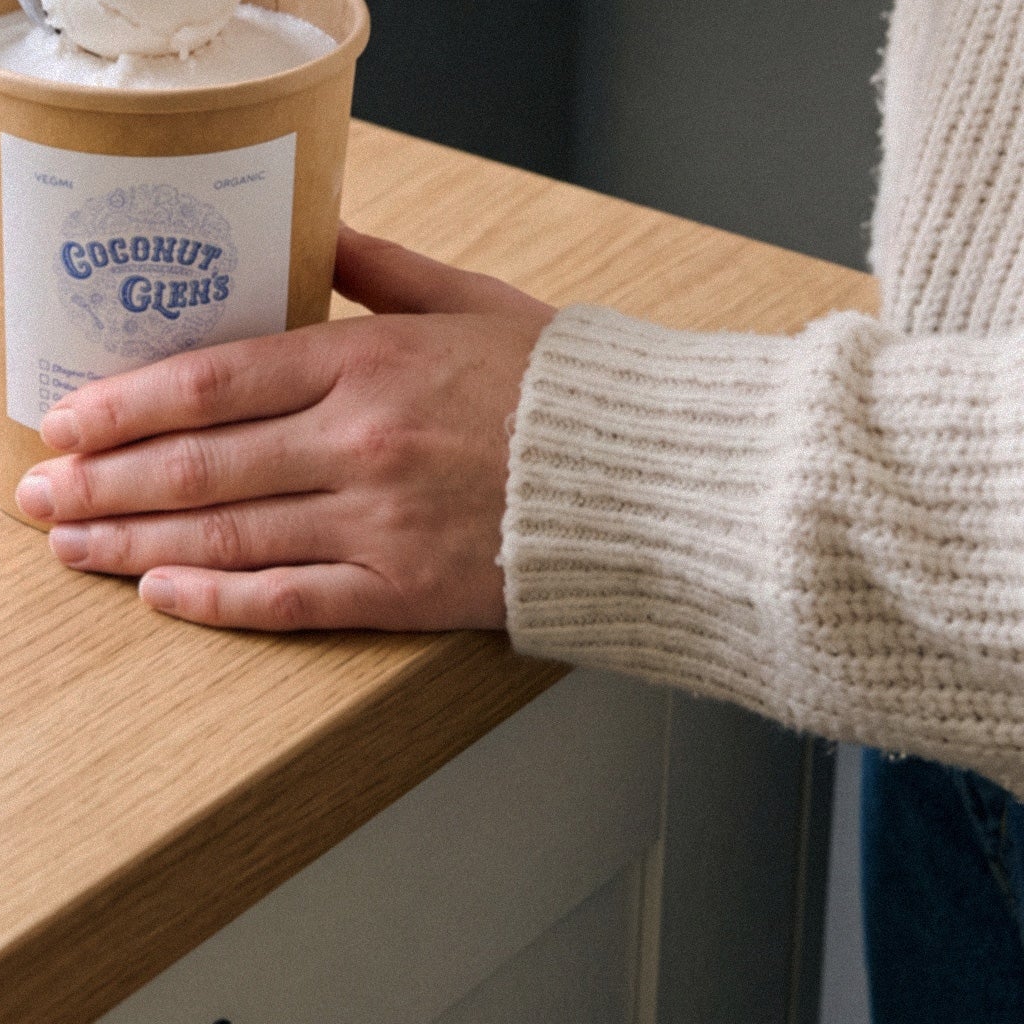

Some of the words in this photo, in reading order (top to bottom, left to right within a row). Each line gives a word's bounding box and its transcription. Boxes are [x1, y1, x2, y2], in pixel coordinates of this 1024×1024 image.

[213, 170, 265, 190] ORGANIC
[61, 235, 222, 280] COCONUT
[120, 269, 229, 320] GLEN'S
